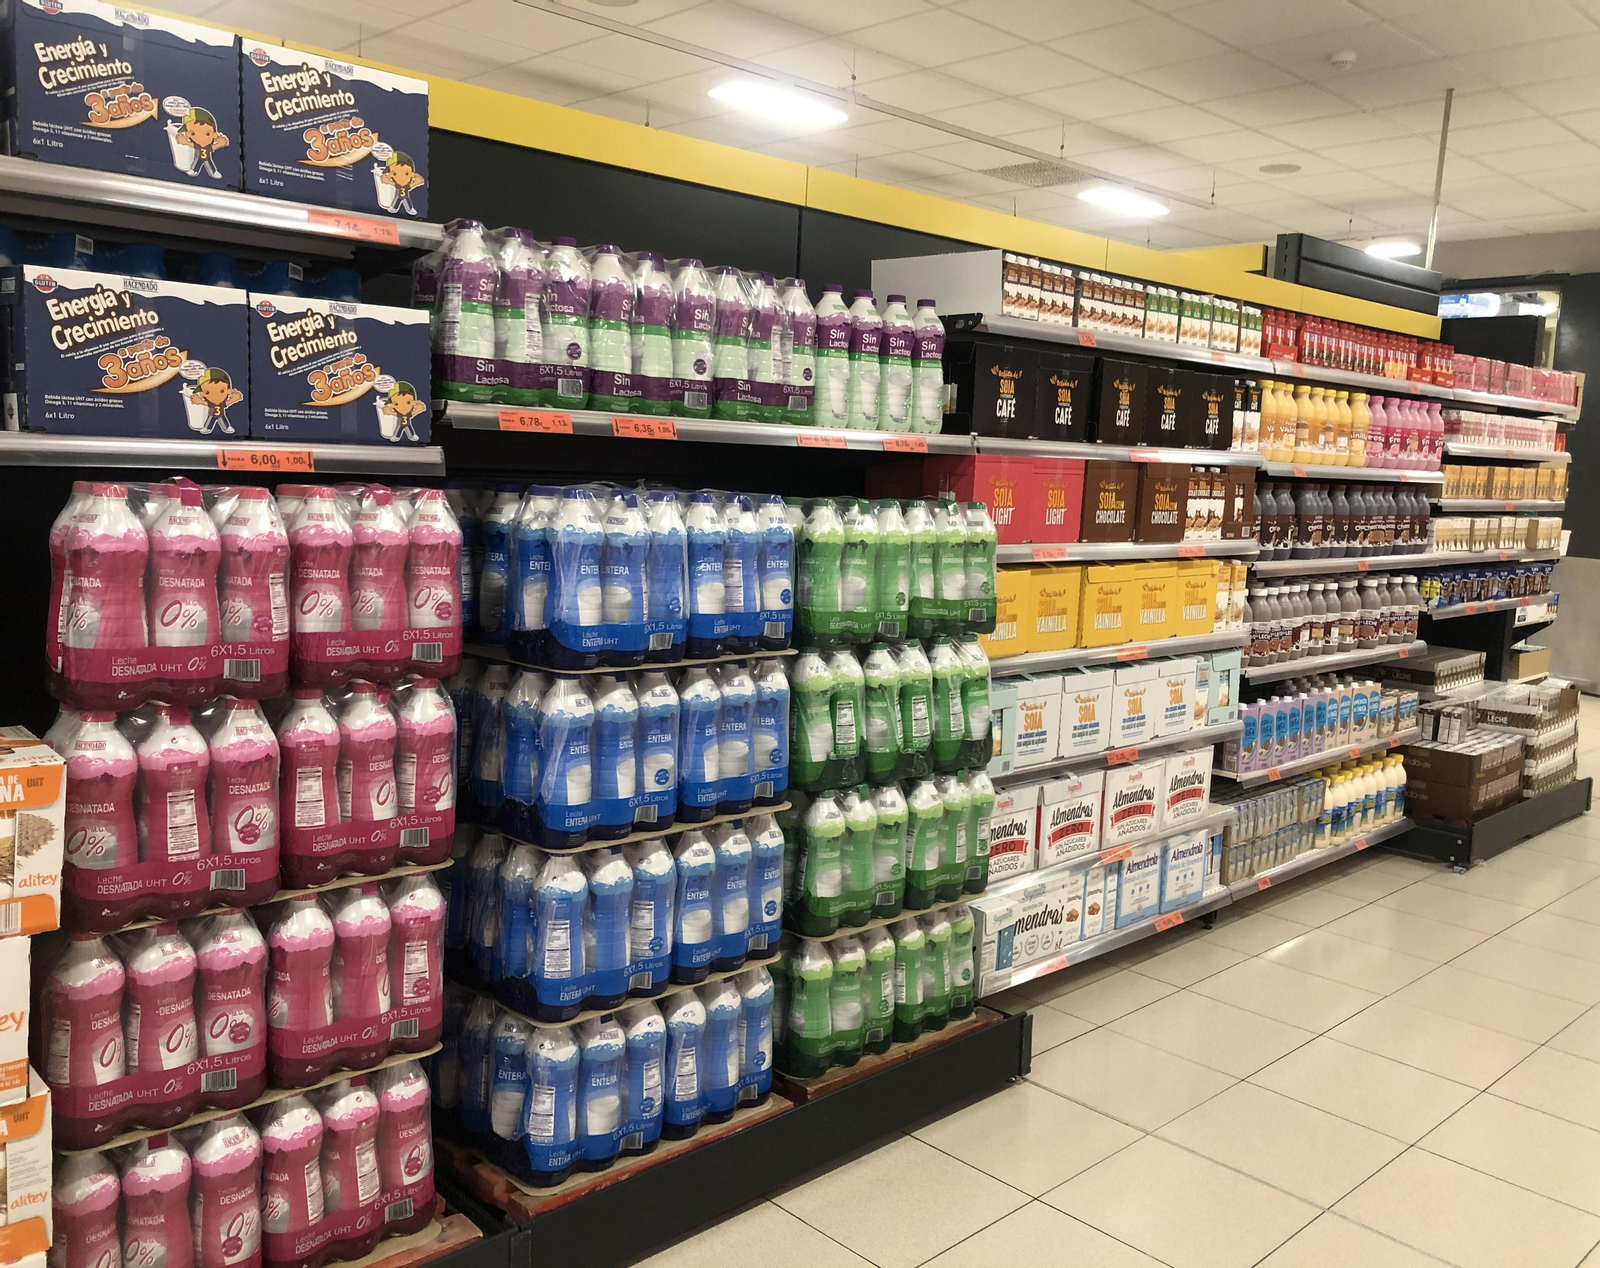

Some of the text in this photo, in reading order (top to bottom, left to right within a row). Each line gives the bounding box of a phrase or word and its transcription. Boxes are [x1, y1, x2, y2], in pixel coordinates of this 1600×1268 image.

[34, 35, 108, 63] Energía y
[38, 58, 132, 89] Crecimiento
[261, 63, 331, 93] Energía y
[85, 93, 154, 124] 3 años
[265, 92, 354, 121] Crecimiento
[33, 137, 63, 147] 6x1 Litro
[304, 128, 374, 162] 3 años
[200, 149, 207, 158] 3
[400, 188, 405, 197] 3
[34, 279, 57, 287] GLUTEN
[123, 279, 157, 291] HACENDADO
[46, 287, 130, 321] Energía y
[694, 309, 709, 320] Sin
[51, 309, 159, 351] Crecimiento
[267, 311, 335, 343] Energía y
[830, 329, 845, 339] Sin
[862, 333, 876, 344] Sin
[890, 337, 905, 348] Sin
[921, 341, 936, 351] Sin
[271, 330, 357, 369] Crecimiento
[98, 348, 182, 388] 3 años
[476, 360, 495, 373] Sin
[539, 365, 582, 377] 6X1,5 Litros
[308, 364, 376, 401] 3 años
[475, 374, 509, 385] Lactosa
[614, 374, 630, 386] Sin
[738, 381, 750, 390] Sin
[613, 387, 642, 396] Lactosa
[737, 392, 761, 403] Lactosa
[214, 406, 221, 416] 3
[996, 398, 1016, 418] CAFÉ
[402, 416, 407, 425] 3
[1055, 406, 1072, 425] CAFÉ
[1116, 409, 1130, 427] CAFÉ
[1161, 413, 1176, 430] CAFÉ
[1205, 418, 1219, 434] CAFÉ
[992, 508, 1015, 525] LIGHT
[1045, 508, 1067, 525] LIGHT
[1096, 510, 1125, 523] CHOCOLATE
[1151, 511, 1178, 524] CHOCOLATE
[601, 566, 630, 575] ENTERA
[767, 560, 789, 569] ENTERA
[299, 568, 340, 579] DESNATADA
[159, 576, 205, 588] DESNATADA
[300, 590, 333, 617] 0%
[1139, 608, 1166, 624] VAINILLA
[1182, 605, 1207, 621] VAINILLA
[1036, 615, 1067, 634] VAINILLA
[1094, 613, 1121, 630] VAINILLA
[402, 630, 430, 641] 6X1,5
[326, 639, 346, 647] Leche
[210, 645, 275, 657] 6X1,5 Litros
[362, 646, 381, 654] UHT
[112, 656, 137, 665] Leche
[112, 663, 182, 677] DESNATADA UHT
[1487, 713, 1508, 725] LECHE
[722, 722, 747, 731] ENTERA
[647, 734, 671, 743] ENTERA
[8, 775, 18, 784] DE
[27, 778, 44, 787] UHT
[1169, 770, 1205, 793] Almendras
[229, 782, 271, 795] DESNATADA
[1113, 785, 1155, 809] Almendras
[1176, 791, 1196, 802] ZERO
[1050, 802, 1093, 829] Almendras
[1121, 805, 1145, 819] ZERO
[389, 815, 442, 829] 6X1,5 Litros
[565, 816, 588, 827] ENTERA
[1060, 826, 1083, 839] ZERO
[349, 836, 367, 844] UHT
[1171, 842, 1203, 862] Almendrola
[196, 855, 261, 871] 6X1,5 Litros
[1126, 853, 1158, 875] Almendrola
[18, 873, 58, 889] alitey
[97, 875, 123, 885] Leche
[97, 878, 167, 895] DESNATADA UHT
[687, 891, 709, 900] ENTERA
[1013, 904, 1064, 936] mendras
[207, 988, 251, 1001] DESNATADA
[340, 1033, 358, 1043] UHT
[225, 1054, 252, 1066] Litros
[498, 1070, 527, 1081] ENTERA
[136, 1088, 159, 1098] UHT
[13, 1111, 30, 1123] UHT
[10, 1191, 48, 1210] alitey
